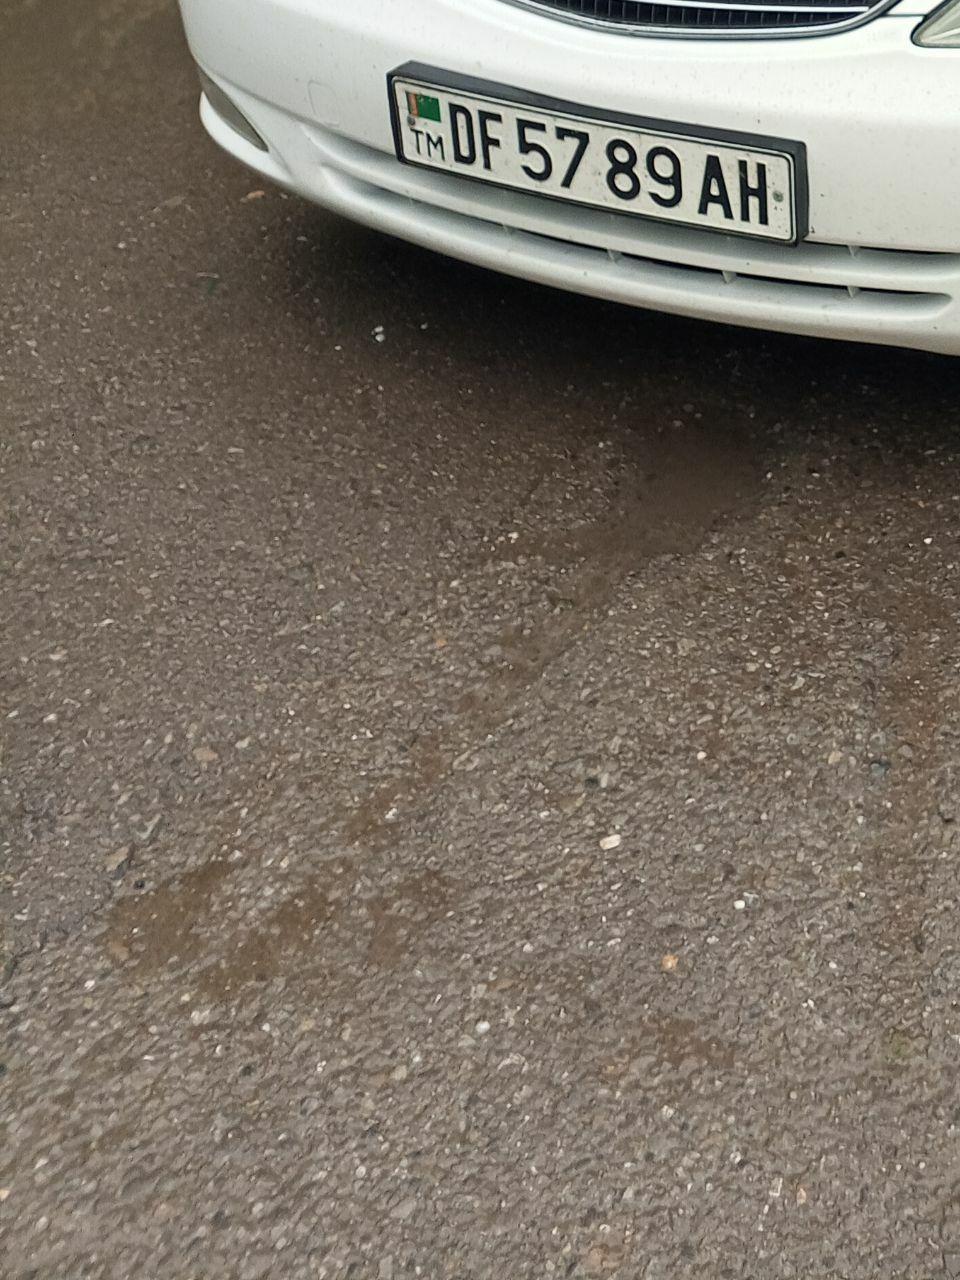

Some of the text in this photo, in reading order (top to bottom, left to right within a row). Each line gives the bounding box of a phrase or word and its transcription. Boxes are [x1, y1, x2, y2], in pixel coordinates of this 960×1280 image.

[410, 127, 446, 161] TM
[448, 102, 503, 170] DF
[697, 154, 769, 225] AH
